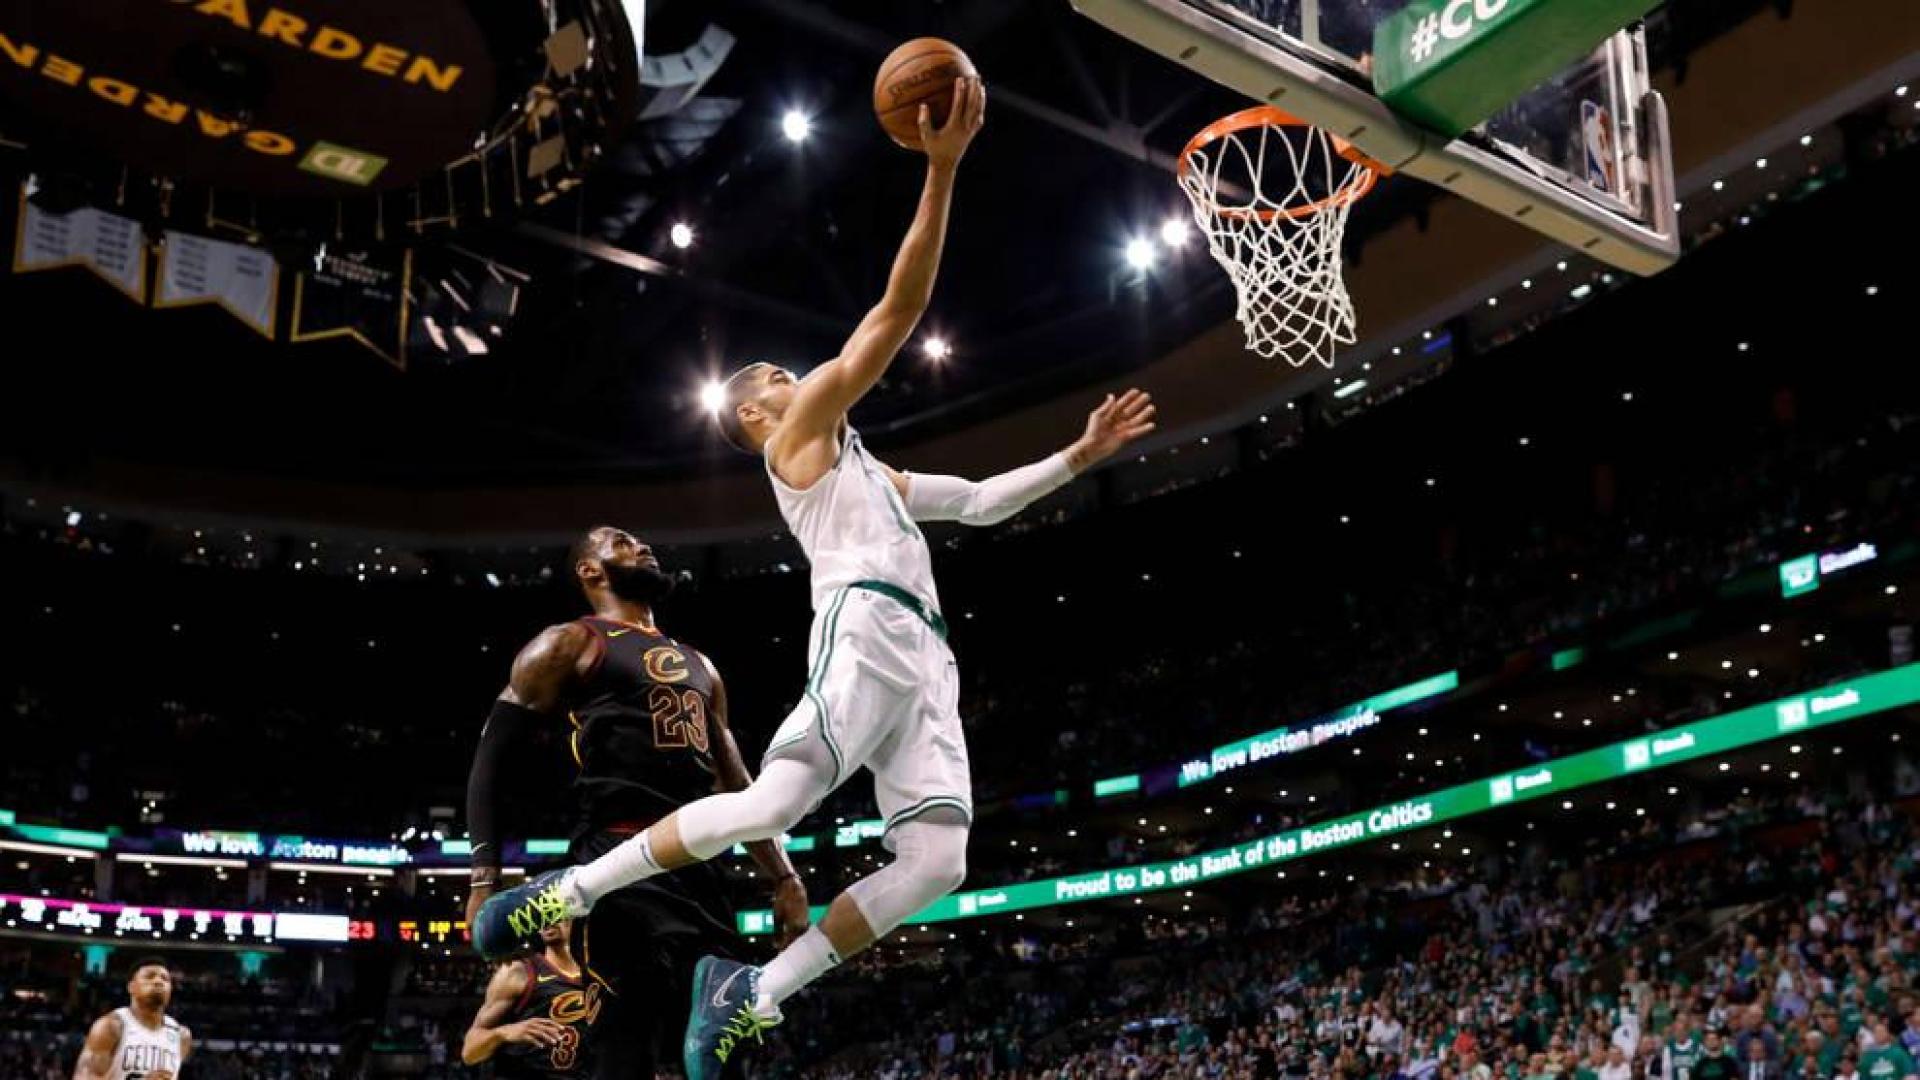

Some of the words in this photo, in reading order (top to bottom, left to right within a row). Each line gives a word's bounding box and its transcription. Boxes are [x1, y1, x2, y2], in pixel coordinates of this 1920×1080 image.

[172, 0, 465, 93] ARDEN
[649, 685, 710, 753] 23
[1182, 760, 1209, 782] We
[1212, 750, 1246, 773] love
[1250, 730, 1309, 761] Boston
[183, 832, 216, 852] We
[1056, 874, 1109, 899] Proud
[1116, 873, 1135, 891] to
[1142, 868, 1165, 888] be
[1171, 862, 1198, 883] the
[1202, 851, 1242, 876] Bank
[1245, 844, 1264, 864] of
[1268, 837, 1296, 859] the
[1301, 821, 1363, 850] Boston
[1369, 802, 1432, 833] Celtics
[550, 1025, 581, 1070] 3
